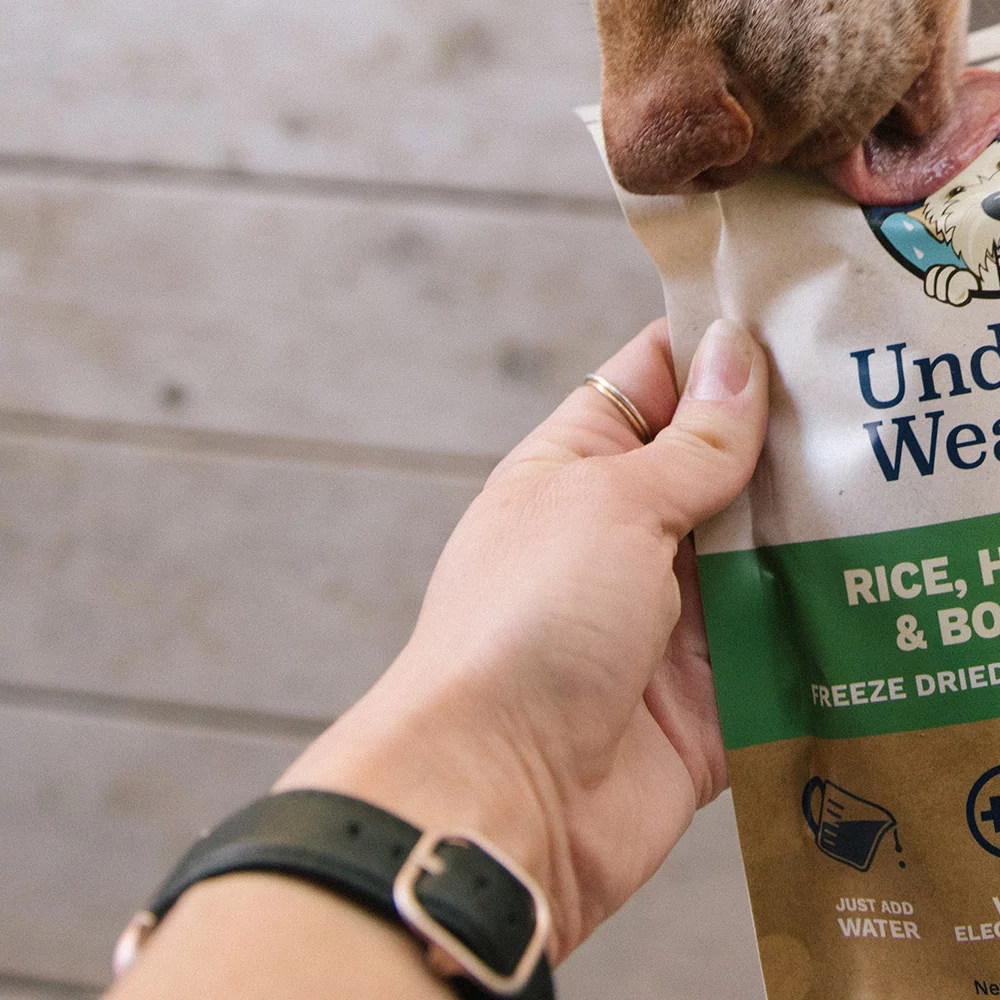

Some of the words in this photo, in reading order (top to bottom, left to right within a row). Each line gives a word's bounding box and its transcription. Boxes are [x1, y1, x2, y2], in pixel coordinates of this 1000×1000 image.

[843, 556, 968, 606] RICE,
[896, 614, 928, 651] &
[811, 677, 907, 708] FREEZE
[836, 898, 876, 912] JUST
[881, 900, 914, 915] ADD
[837, 917, 921, 940] WATER
